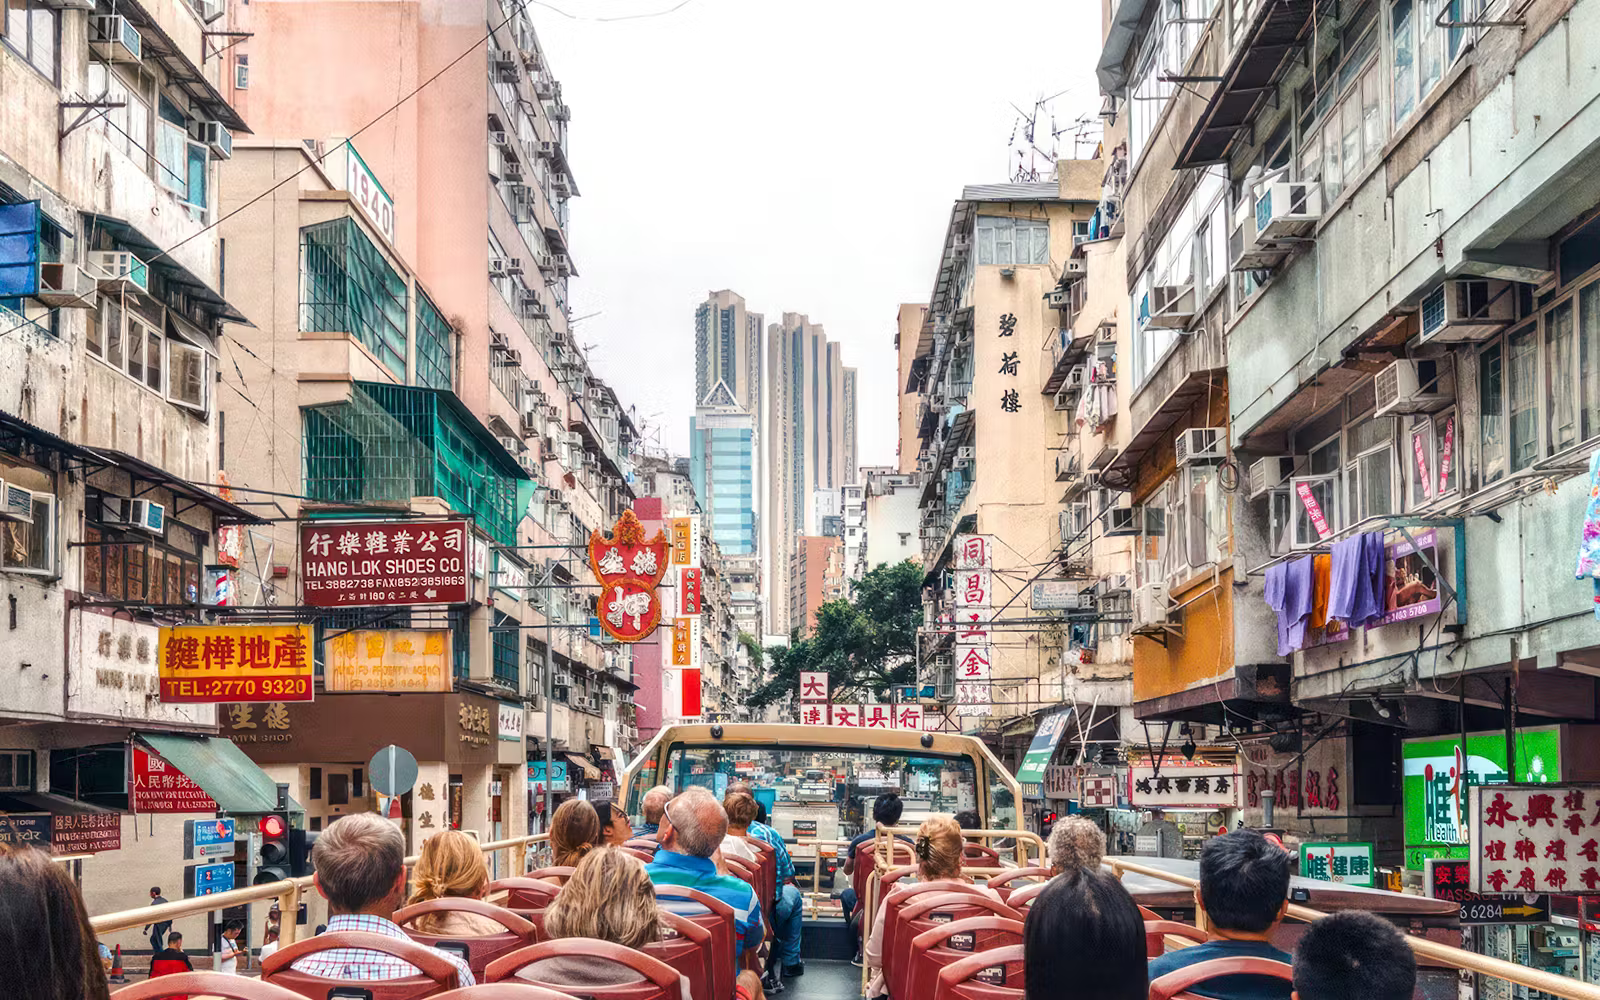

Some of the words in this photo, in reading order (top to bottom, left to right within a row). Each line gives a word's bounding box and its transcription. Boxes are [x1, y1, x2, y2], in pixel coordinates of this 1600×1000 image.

[353, 162, 390, 236] 1940
[998, 313, 1022, 412] 碧荷樓
[307, 528, 463, 557] 行樂鞋業公司
[306, 561, 348, 577] HANG
[351, 559, 382, 576] LOK
[385, 558, 436, 574] SHOES
[439, 557, 464, 573] CO.
[305, 580, 324, 590] TEL
[960, 537, 990, 676] 同昌五金
[165, 635, 307, 670] 鍵樺地產
[167, 679, 256, 697] TEL:2770
[261, 679, 307, 695] 9320
[803, 676, 826, 697] 大
[803, 707, 920, 729] 達文具行
[1484, 793, 1558, 828] 永興
[1470, 904, 1503, 919] 6284
